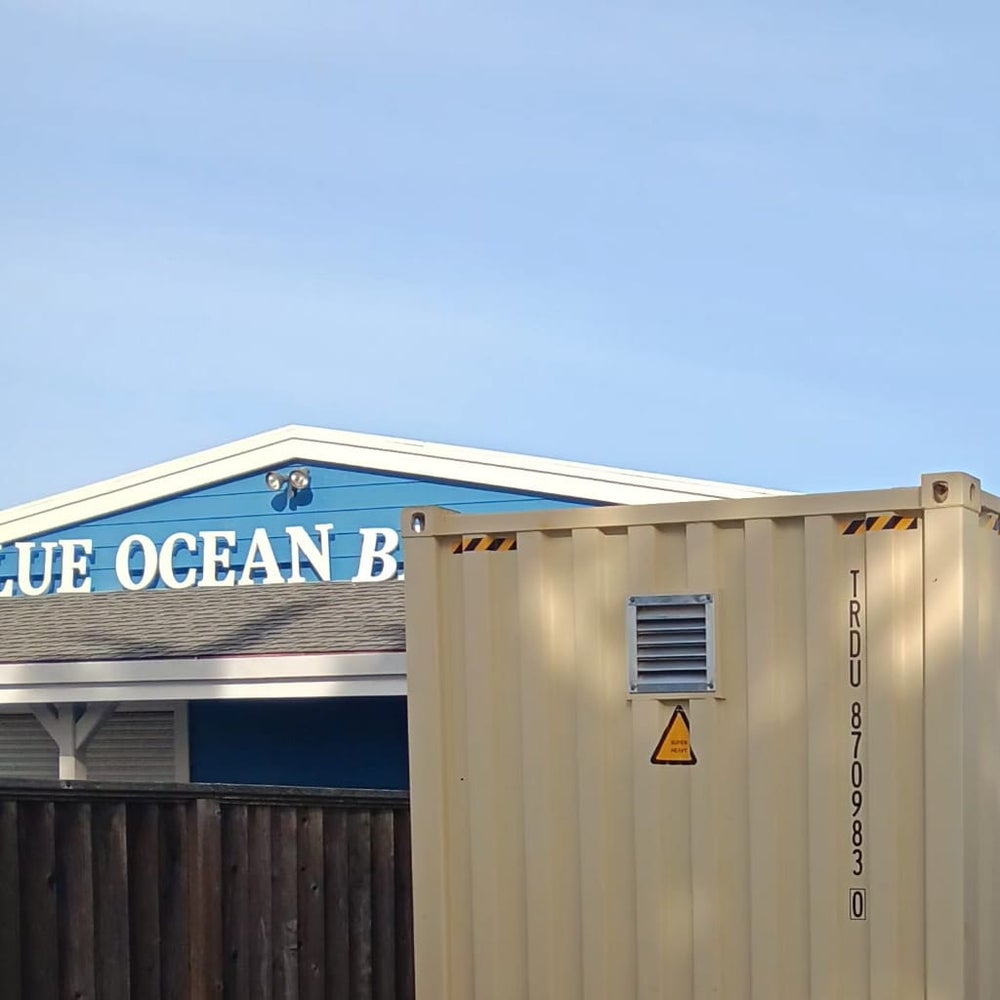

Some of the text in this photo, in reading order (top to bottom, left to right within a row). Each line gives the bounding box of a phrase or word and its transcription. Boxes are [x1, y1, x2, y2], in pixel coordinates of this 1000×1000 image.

[115, 523, 334, 591] OCEAN
[351, 527, 405, 582] B
[849, 569, 865, 919] TRDU 870983 0
